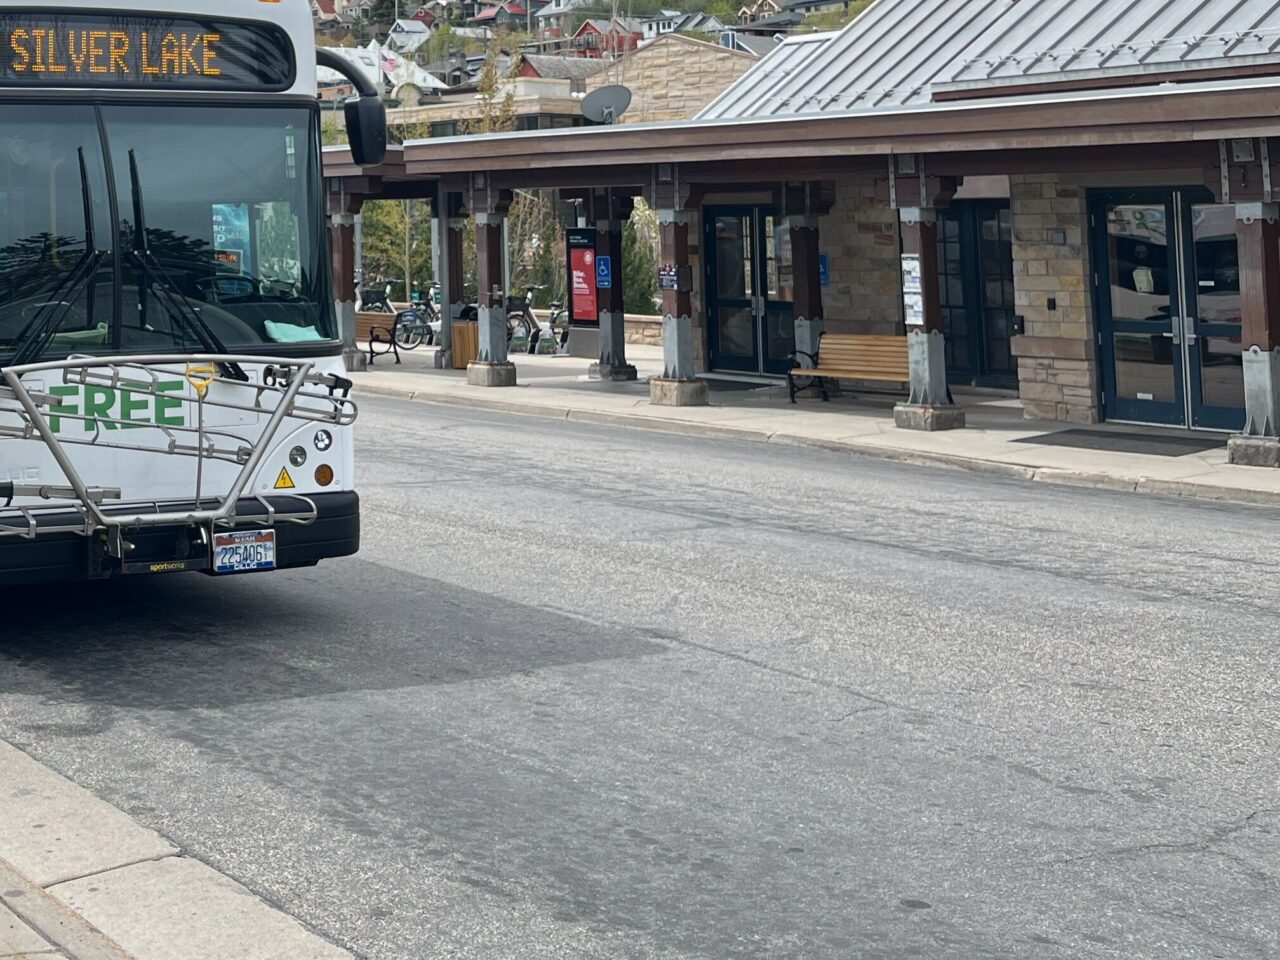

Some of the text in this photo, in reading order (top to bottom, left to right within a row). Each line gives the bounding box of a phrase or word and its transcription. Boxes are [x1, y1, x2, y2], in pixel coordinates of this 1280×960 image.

[10, 29, 129, 73] SILVER
[141, 32, 221, 75] LAKE
[49, 380, 185, 433] FREE
[150, 561, 185, 572] sportworks
[221, 544, 263, 565] 225406
